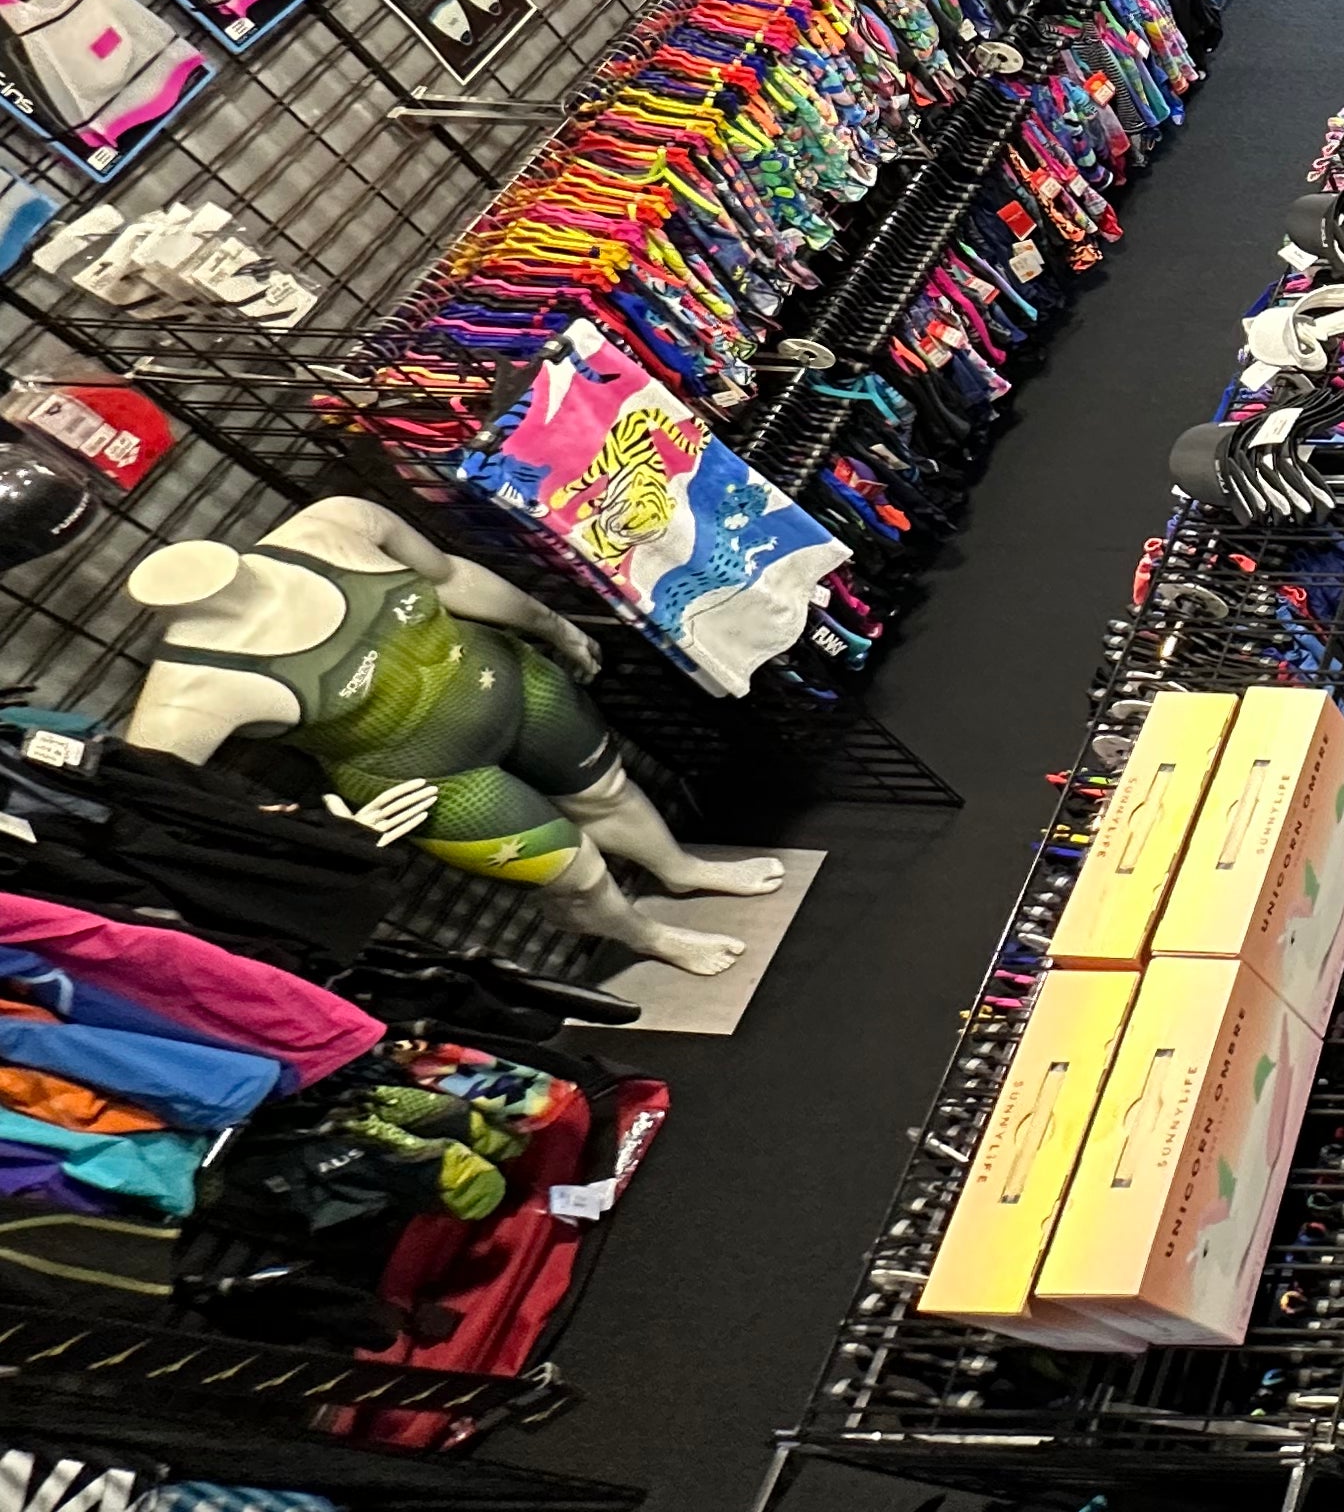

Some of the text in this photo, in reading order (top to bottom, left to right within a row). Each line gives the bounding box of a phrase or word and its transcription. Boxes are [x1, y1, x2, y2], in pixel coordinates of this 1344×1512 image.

[339, 649, 378, 698] speedo
[812, 625, 848, 656] FUNKY
[1097, 776, 1138, 858] SUNNYLIFE
[1256, 773, 1291, 855] SUNNYLIFE
[1261, 821, 1303, 933] UNICORN
[1302, 733, 1328, 809] OMBRE
[976, 1080, 1025, 1185] SUNNYLIFE
[1157, 1066, 1199, 1168] SUNNYLIFE
[1165, 1116, 1213, 1257] UNICORN
[1214, 1007, 1246, 1102] OMBRE
